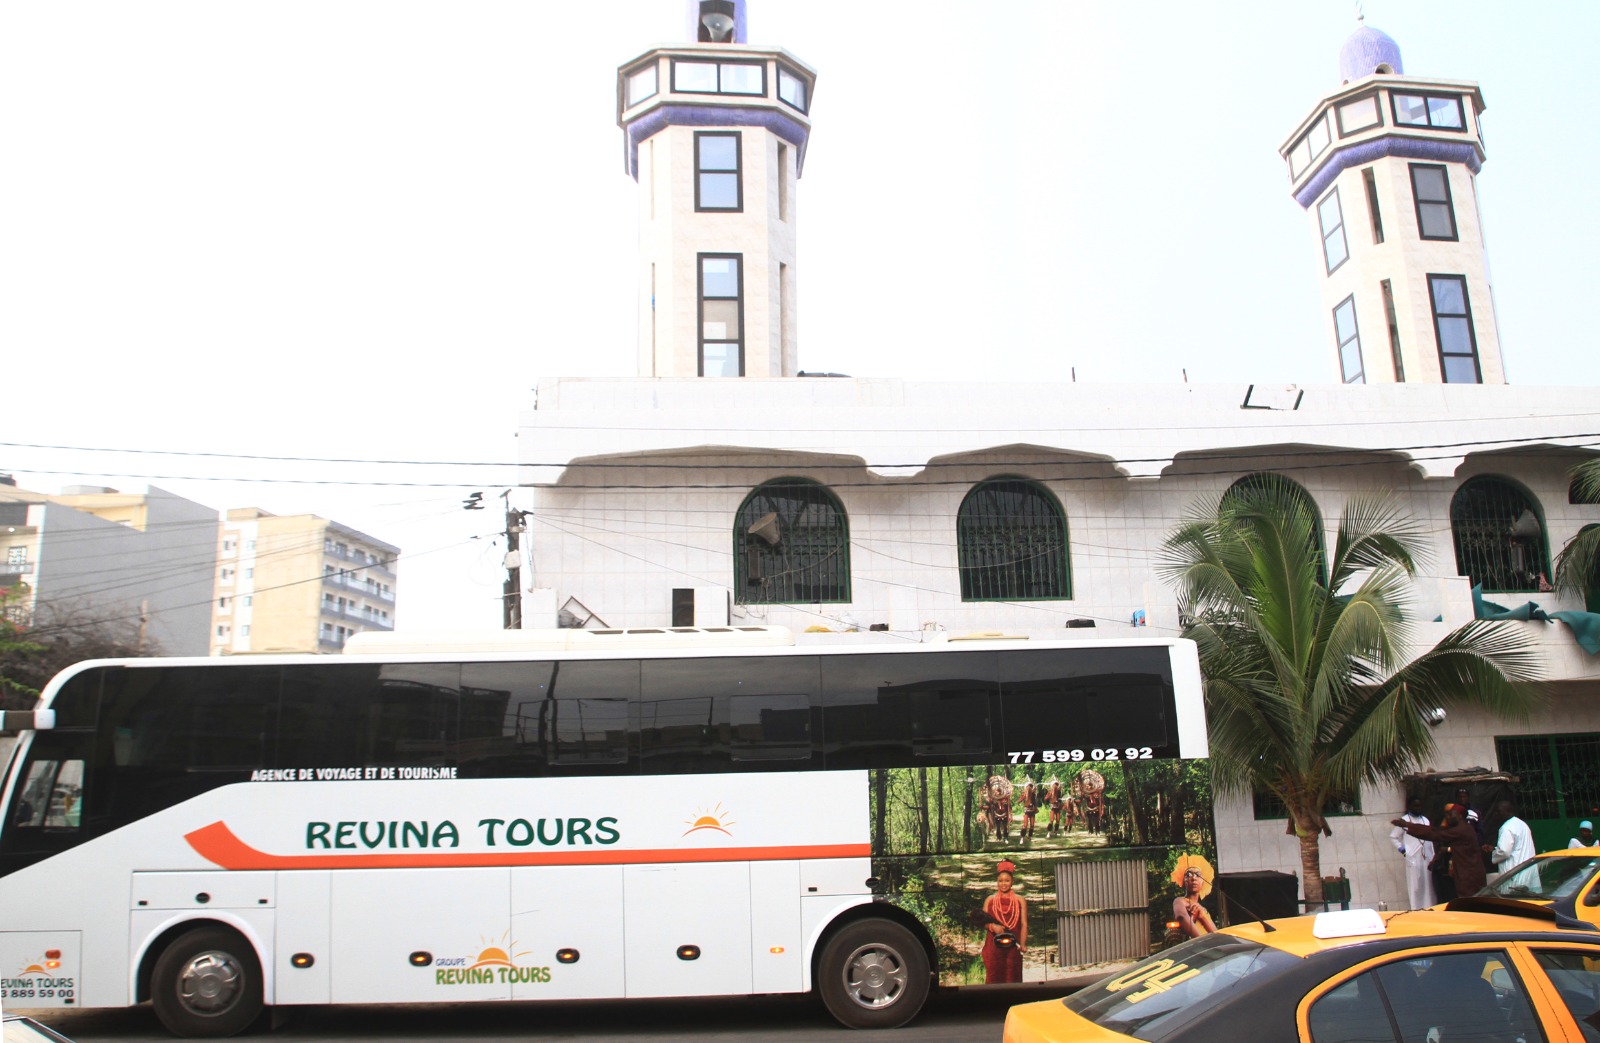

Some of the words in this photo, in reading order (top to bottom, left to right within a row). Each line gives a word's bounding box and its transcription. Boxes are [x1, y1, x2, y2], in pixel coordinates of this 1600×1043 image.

[1007, 751, 1035, 764] 77
[1042, 749, 1084, 762] 599
[1091, 748, 1119, 761] 02
[1124, 747, 1153, 760] 92
[251, 769, 296, 781] AGENCE
[298, 768, 314, 780] DE
[316, 768, 362, 780] VOYAGE
[365, 767, 378, 779] ET
[380, 767, 396, 779] DE
[398, 767, 458, 779] TOURISME
[306, 820, 460, 849] REVINA
[478, 817, 621, 847] TOURS
[435, 958, 466, 966] GROUPE
[1, 978, 34, 988] EVINA
[36, 978, 74, 988] TOURS
[436, 968, 494, 985] REVINA
[498, 967, 551, 984] TOURS
[1, 989, 8, 998] 3
[11, 989, 35, 998] 889
[39, 989, 54, 998] 59
[58, 989, 74, 998] 00
